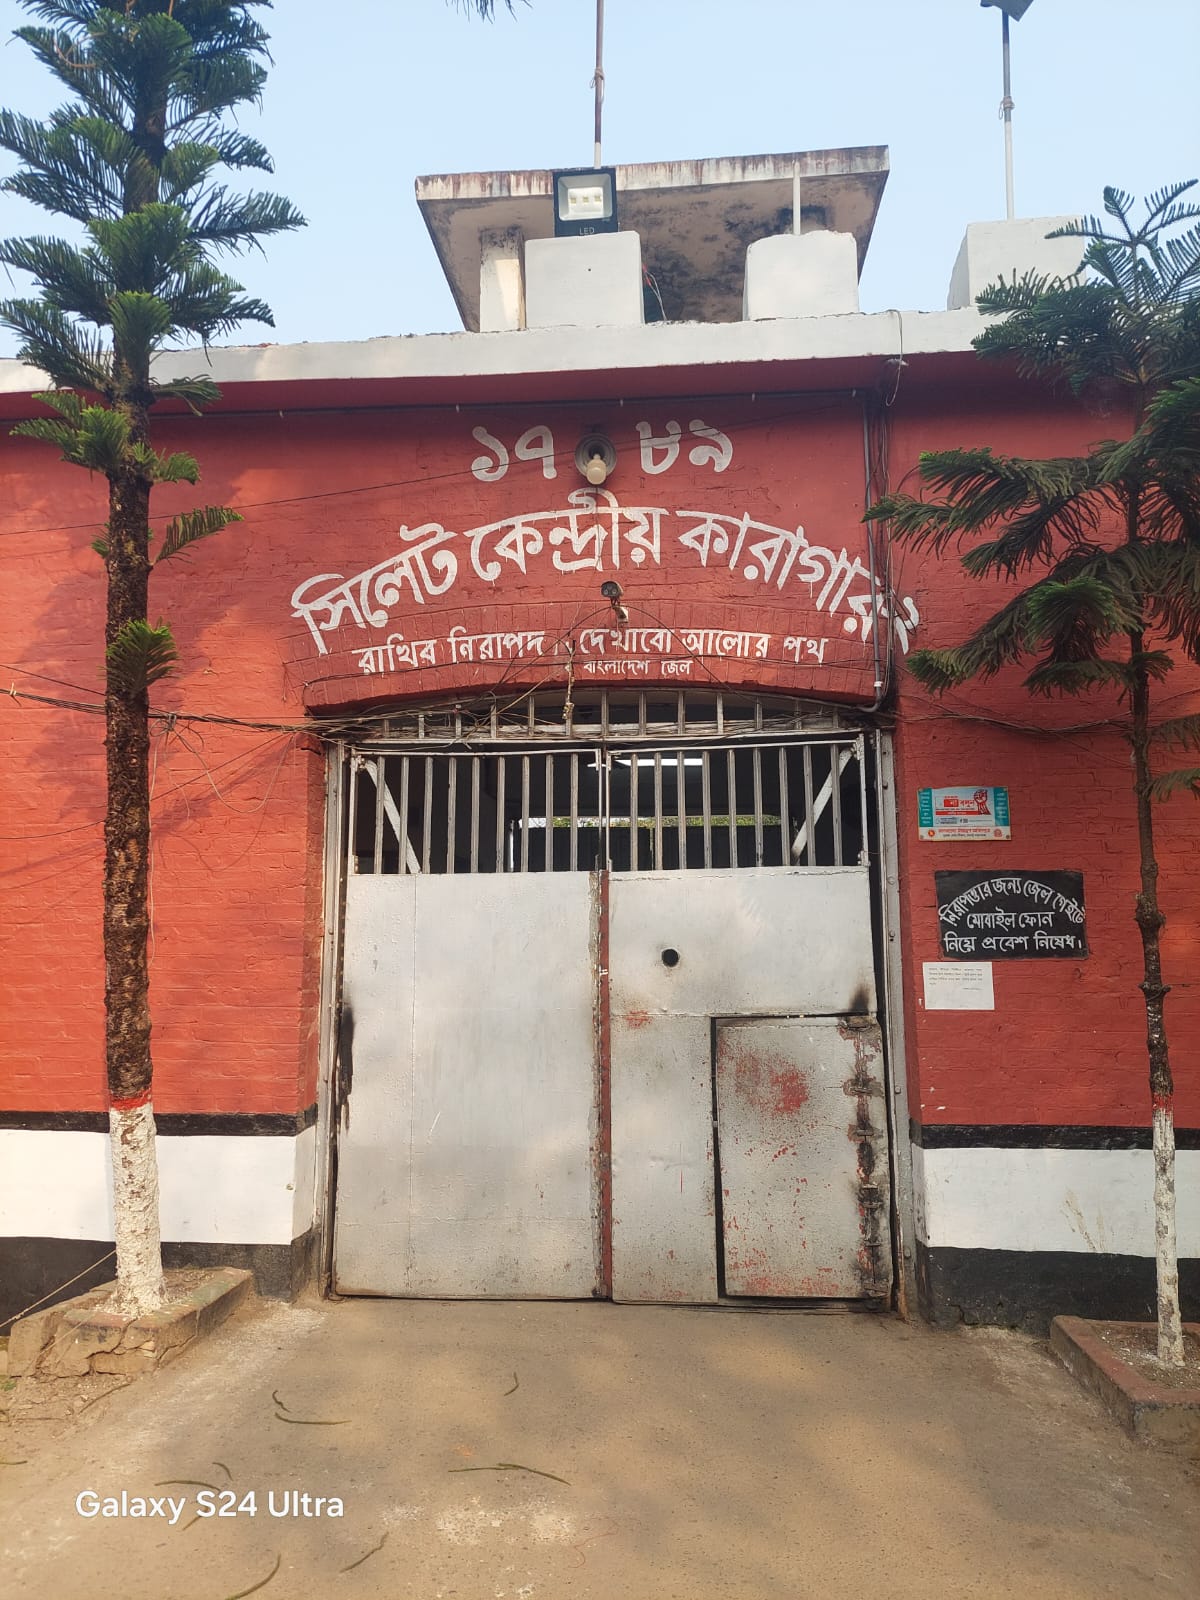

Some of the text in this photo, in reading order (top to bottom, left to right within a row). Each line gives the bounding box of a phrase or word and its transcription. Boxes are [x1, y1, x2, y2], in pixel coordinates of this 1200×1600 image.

[580, 227, 594, 235] LED
[471, 419, 734, 482] ১৭ ৮৯
[291, 522, 458, 656] সিলেট
[463, 487, 669, 583] কেন্দ্রীয়
[681, 628, 772, 658] আলোর
[783, 636, 829, 664] পথ
[583, 660, 694, 676] বাংলাদেশ জেল
[938, 880, 993, 927] নিরাপত্তার
[990, 877, 1022, 896] জন্য
[1023, 879, 1055, 905] জেল
[966, 906, 1055, 932] মোবাইল ফোন
[943, 930, 977, 953] নিয়ে
[981, 935, 1029, 952] প্রবেশ
